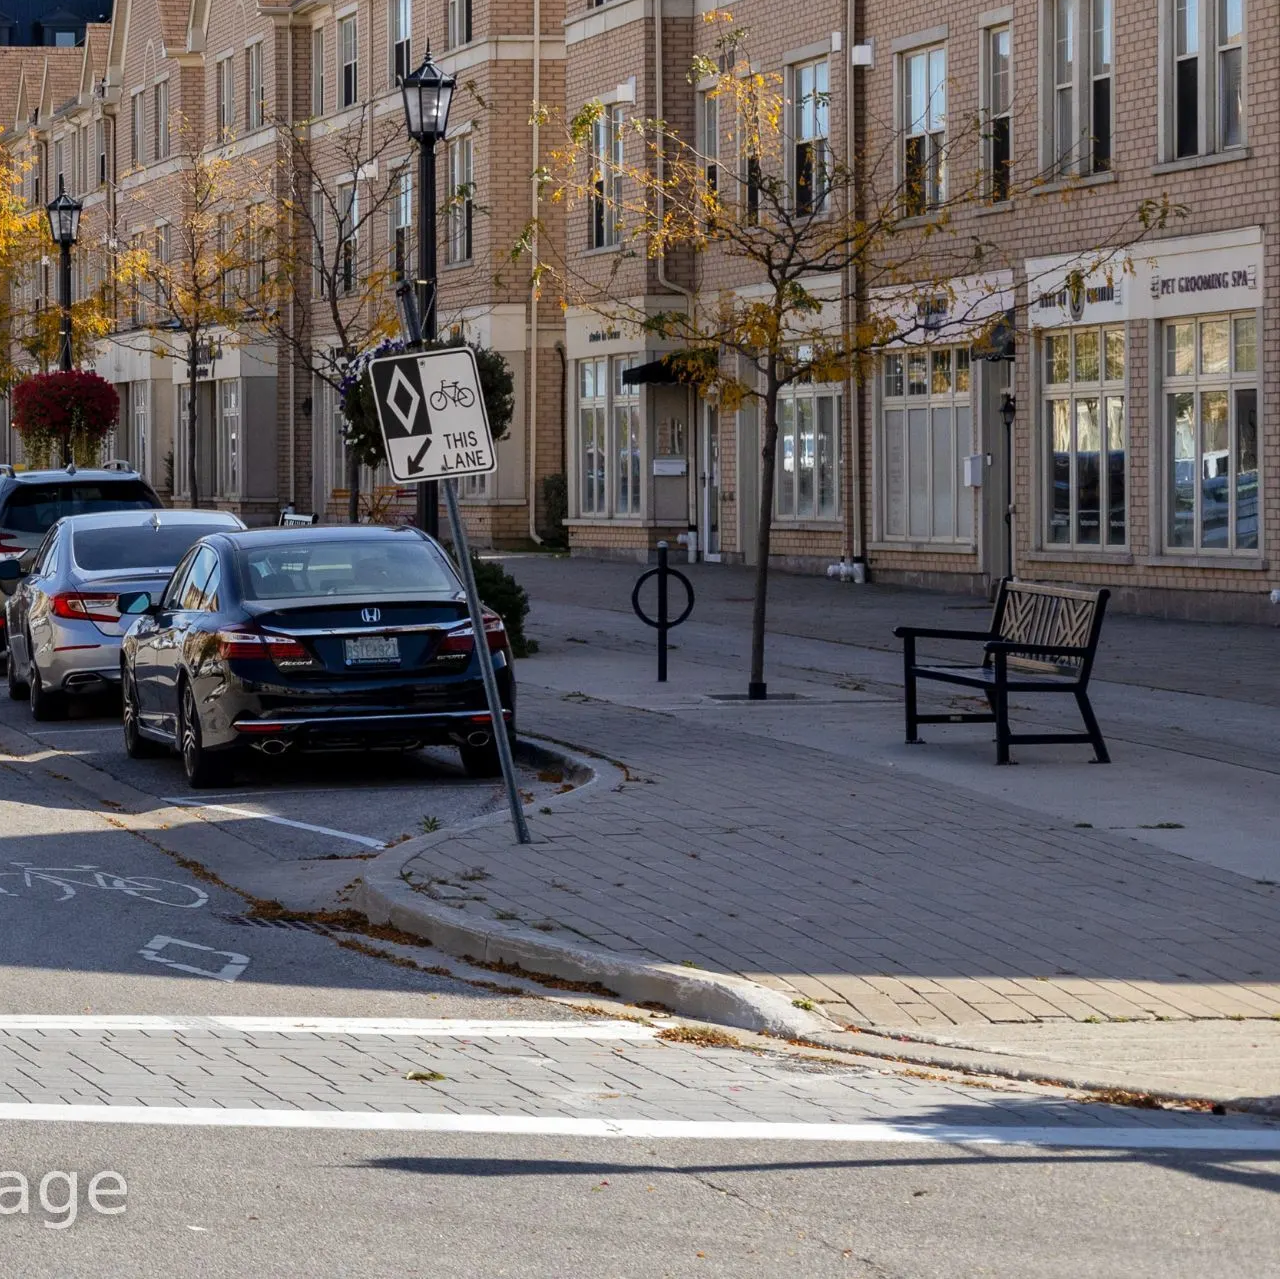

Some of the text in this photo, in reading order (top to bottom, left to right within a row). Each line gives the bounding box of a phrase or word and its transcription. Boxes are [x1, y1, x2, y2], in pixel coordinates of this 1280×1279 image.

[1160, 270, 1248, 295] PET GROOMING SPA
[442, 430, 478, 450] THIS
[442, 450, 487, 470] LANE
[278, 659, 313, 667] Accord
